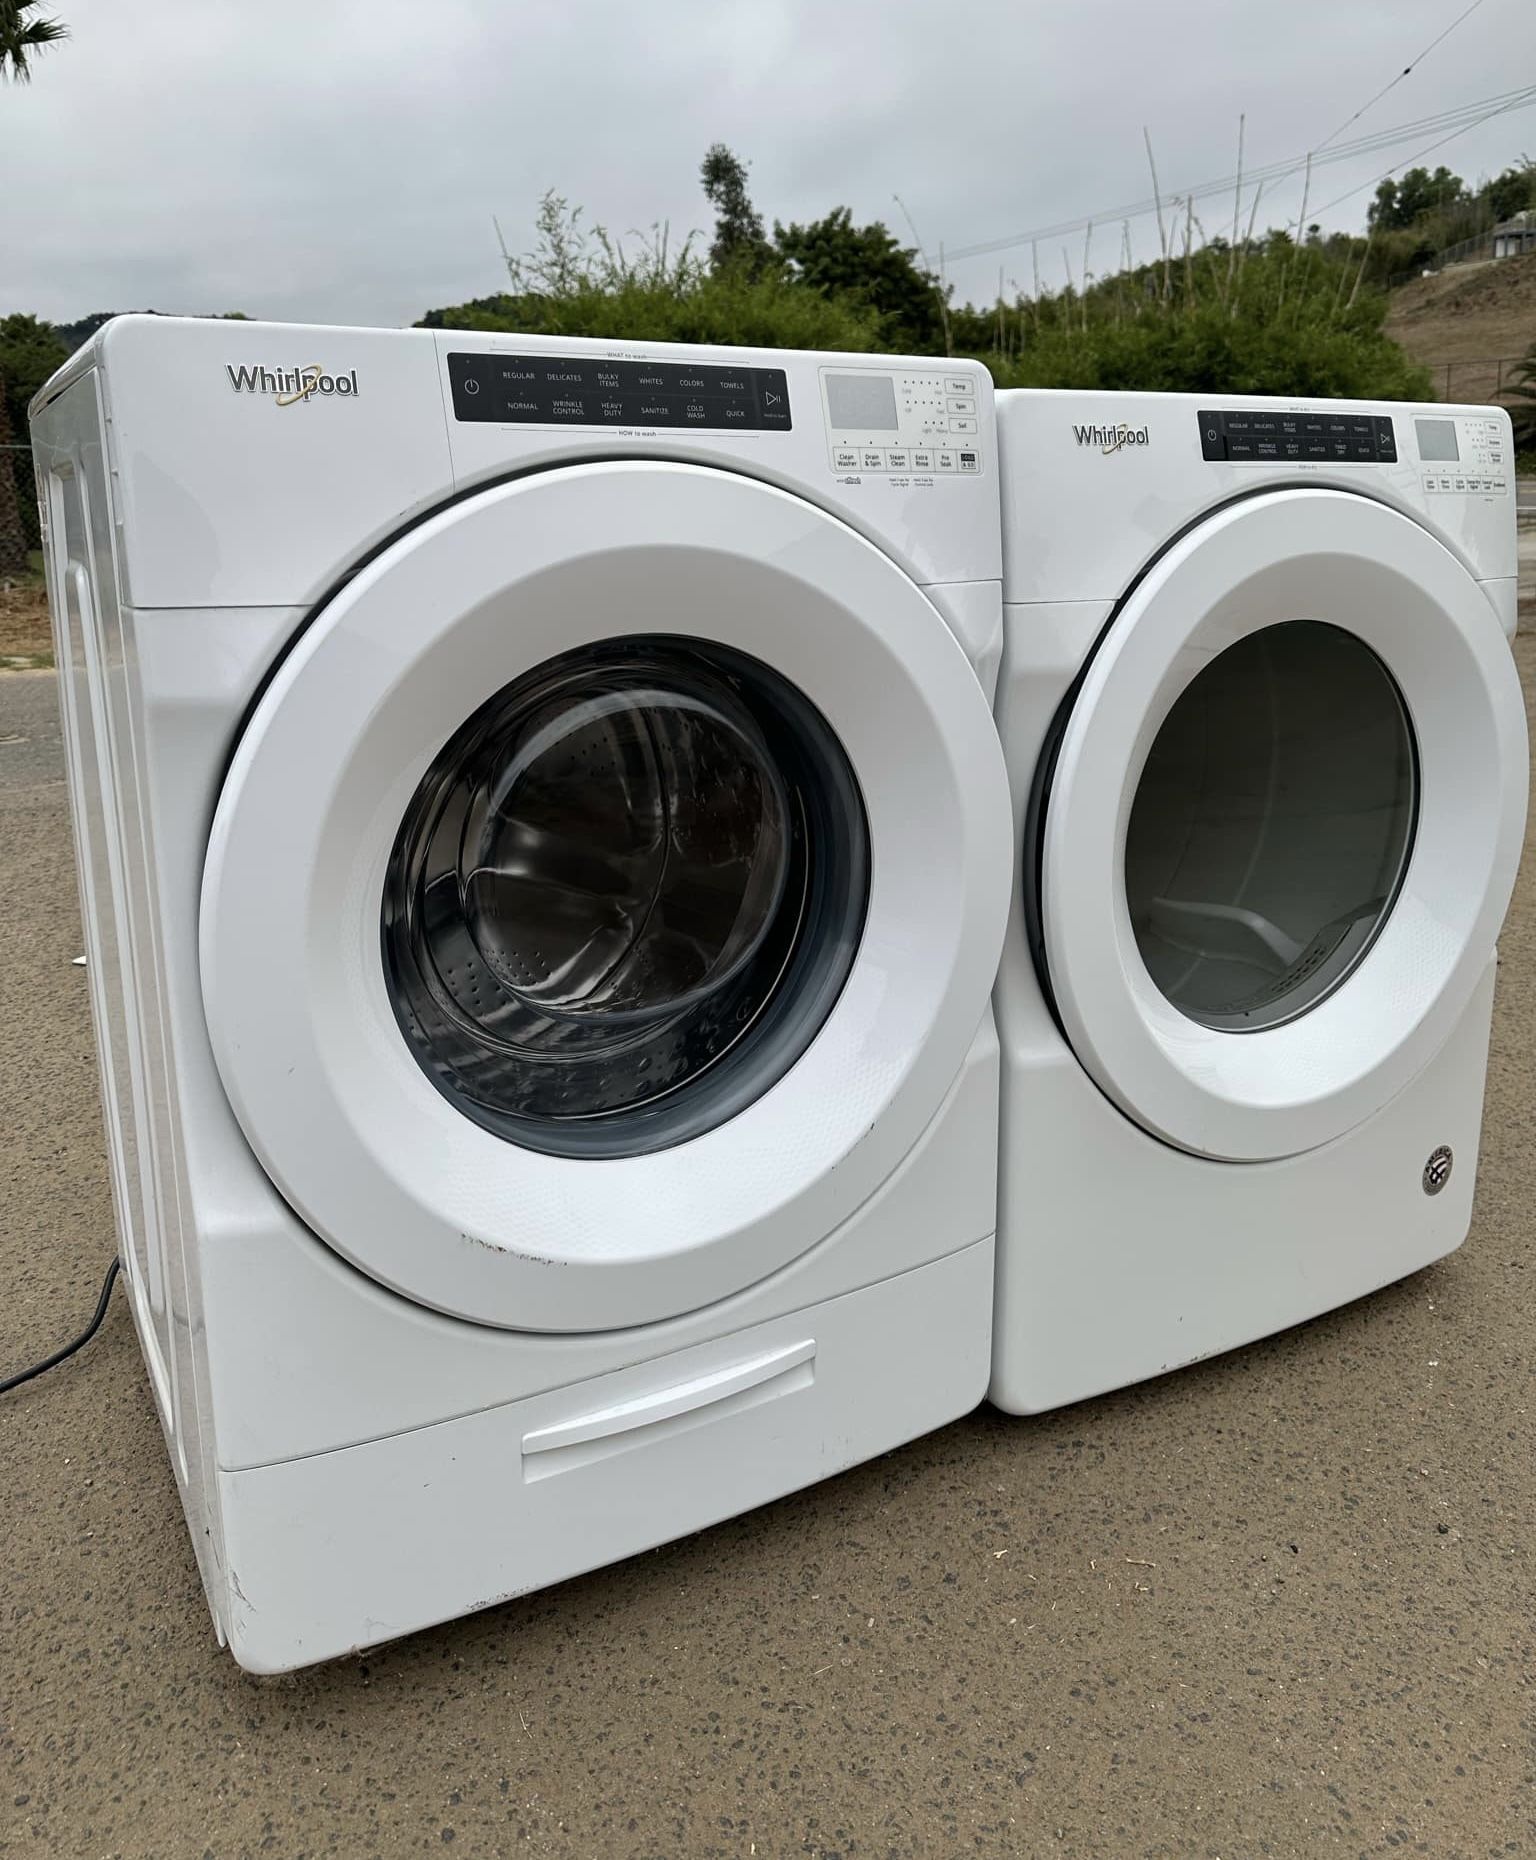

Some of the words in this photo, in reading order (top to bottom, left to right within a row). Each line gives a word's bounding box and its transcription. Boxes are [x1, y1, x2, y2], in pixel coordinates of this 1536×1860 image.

[502, 371, 536, 380] REGULAR
[547, 373, 582, 382] DELICATES
[598, 372, 619, 380] BULKY
[224, 364, 359, 402] Whirlpool
[599, 380, 620, 388] ITEMS
[639, 377, 663, 386] WHITES
[679, 379, 704, 387] COLORS
[720, 381, 744, 390] TOWELS
[952, 383, 966, 391] Temp
[507, 402, 539, 410] NORMAL
[552, 400, 583, 408] WRINKLE
[553, 408, 585, 416] CONTROL
[604, 409, 622, 417] DUTY
[641, 407, 669, 415] SANITIZE
[688, 411, 705, 419] WASH
[726, 410, 745, 418] QUICK
[1073, 425, 1149, 451] Whirlpool
